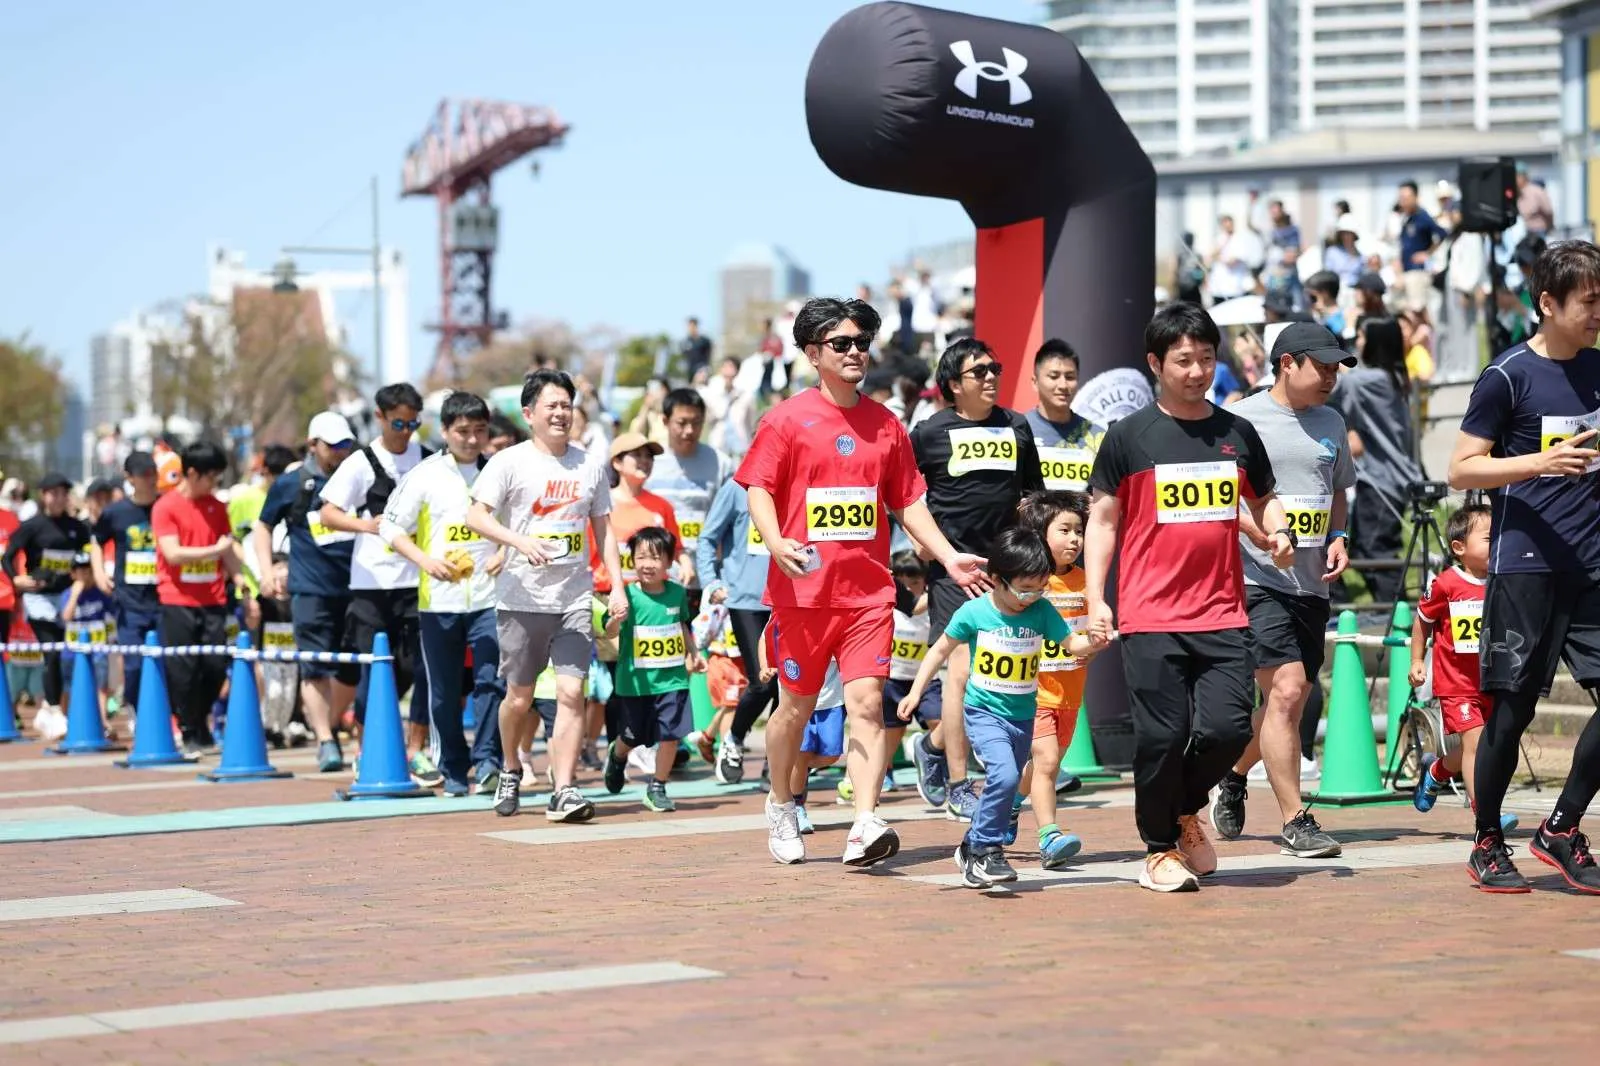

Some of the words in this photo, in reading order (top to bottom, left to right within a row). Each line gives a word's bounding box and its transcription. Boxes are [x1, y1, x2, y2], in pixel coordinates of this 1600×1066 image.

[946, 104, 986, 120] UNDER
[986, 112, 1034, 128] ARMOUR
[1100, 389, 1123, 410] ALL
[958, 441, 1013, 459] 2929
[1040, 461, 1090, 480] 3056
[545, 480, 581, 498] NIKE
[1163, 480, 1234, 508] 3019
[812, 504, 874, 528] 2930
[1286, 512, 1328, 534] 2987
[449, 525, 480, 541] 29
[639, 637, 683, 657] 2938
[979, 651, 1038, 680] 3019
